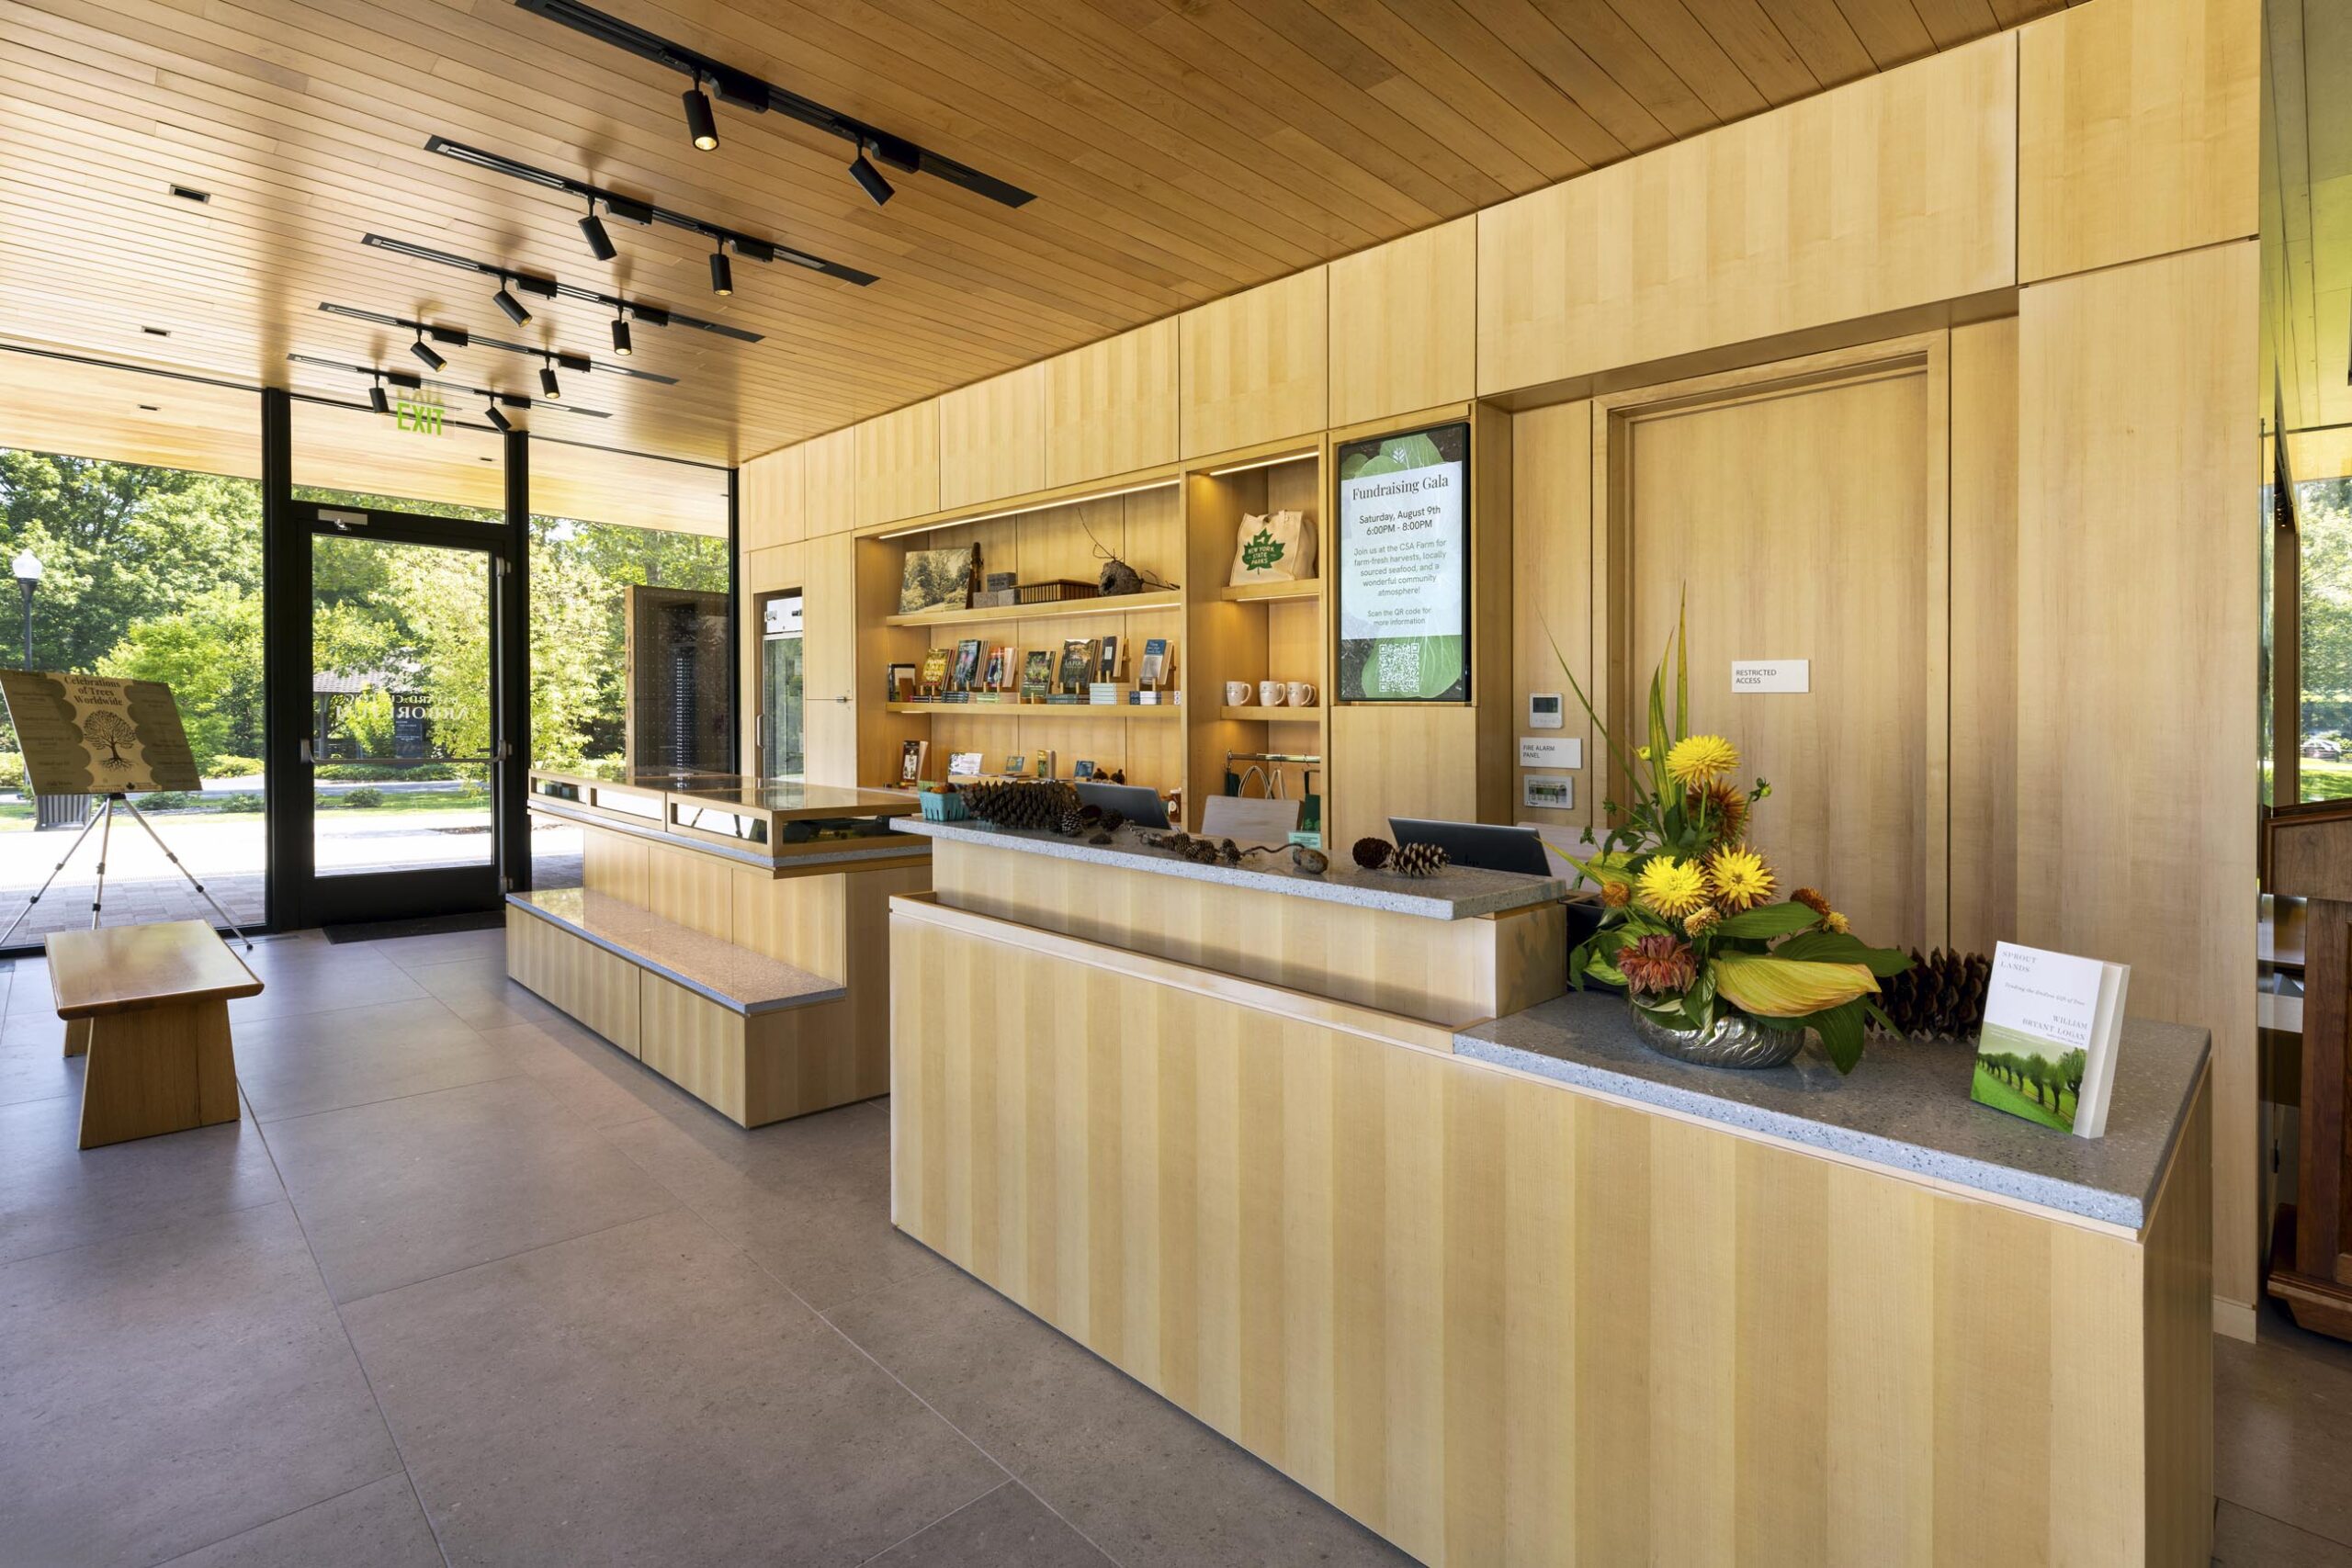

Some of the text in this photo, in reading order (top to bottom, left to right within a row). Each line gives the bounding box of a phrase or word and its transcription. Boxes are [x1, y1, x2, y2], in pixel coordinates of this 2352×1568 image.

[398, 402, 445, 435] EXIT
[1352, 474, 1449, 501] Fundraising Gala
[1360, 505, 1441, 524] Saturday, August 9th
[1366, 525, 1396, 536] 6:00PM
[1402, 520, 1432, 531] 8:00PM
[1399, 542, 1415, 551] CSA
[1416, 541, 1434, 549] Farm
[1354, 550, 1447, 567] farm-fresh harvests, locally
[1360, 568, 1387, 577] sourced
[1388, 564, 1418, 573] seafood,
[1419, 562, 1433, 571] and
[1363, 574, 1437, 587] wonderful community
[1378, 586, 1420, 597] atmosphere!
[1394, 608, 1404, 616] QR
[1405, 607, 1421, 615] code
[1390, 617, 1426, 626] information
[64, 675, 120, 688] Celebrations
[78, 685, 115, 696] of Trees
[74, 694, 124, 706] Worldwide
[2002, 951, 2037, 964] SPROUT
[2000, 961, 2030, 973] LANDS
[2022, 1017, 2055, 1032] BRYANT
[2057, 1028, 2086, 1041] LOGAN
[2052, 1015, 2087, 1030] WILLIAM
